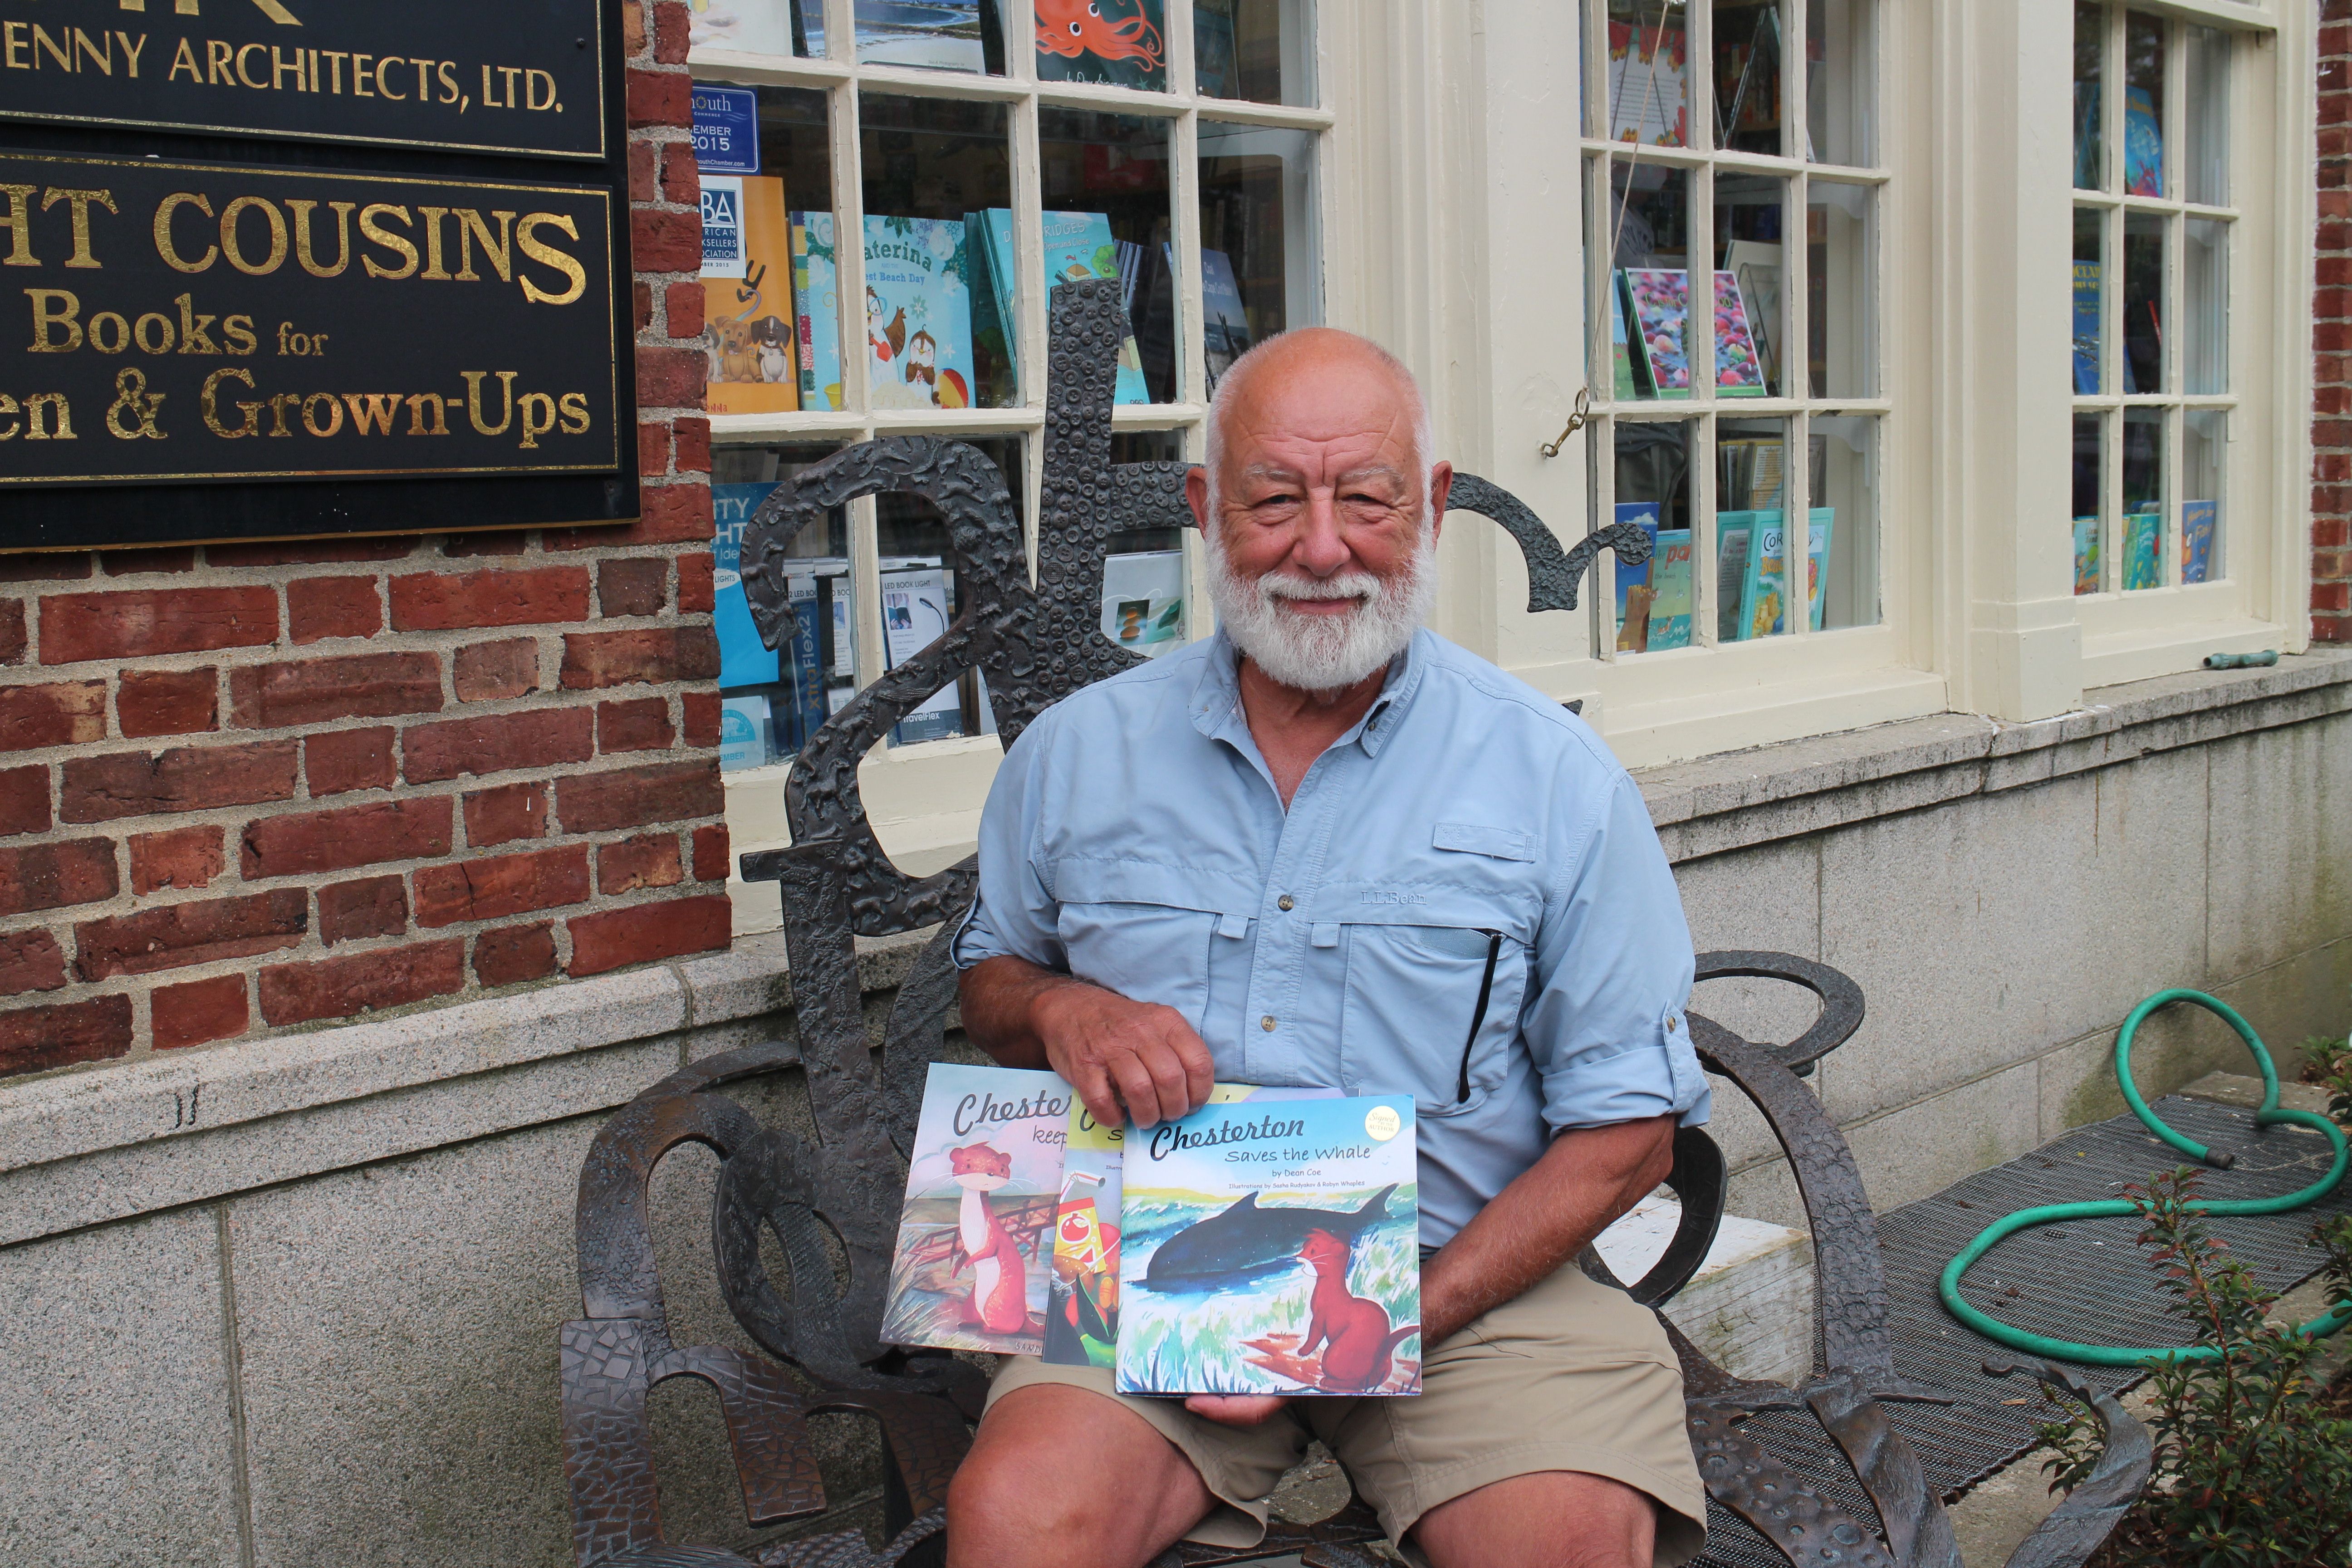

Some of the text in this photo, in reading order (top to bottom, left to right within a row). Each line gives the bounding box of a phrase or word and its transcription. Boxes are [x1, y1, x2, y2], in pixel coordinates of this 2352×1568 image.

[168, 37, 470, 114] ARCHITECTS,
[481, 65, 564, 113] LTD.
[691, 125, 731, 136] EMBER
[691, 136, 730, 151] 2015
[702, 228, 736, 236] RICAN
[1072, 238, 1089, 246] Close
[153, 191, 587, 307] COUSINS
[879, 272, 906, 282] Beach
[908, 273, 925, 286] Day
[24, 288, 328, 357] Books for
[106, 367, 169, 440] &
[200, 368, 591, 449] Grown-Ups
[884, 582, 895, 590] LED
[897, 581, 914, 589] BOOK
[1369, 1112, 1396, 1124] Signed
[1368, 1124, 1395, 1132] AUTHOR
[1150, 1115, 1304, 1161] Chesterton
[1283, 1147, 1309, 1161] the
[1272, 1169, 1282, 1178] by
[1284, 1169, 1305, 1177] Dean
[1290, 1181, 1316, 1190] Rudyakov
